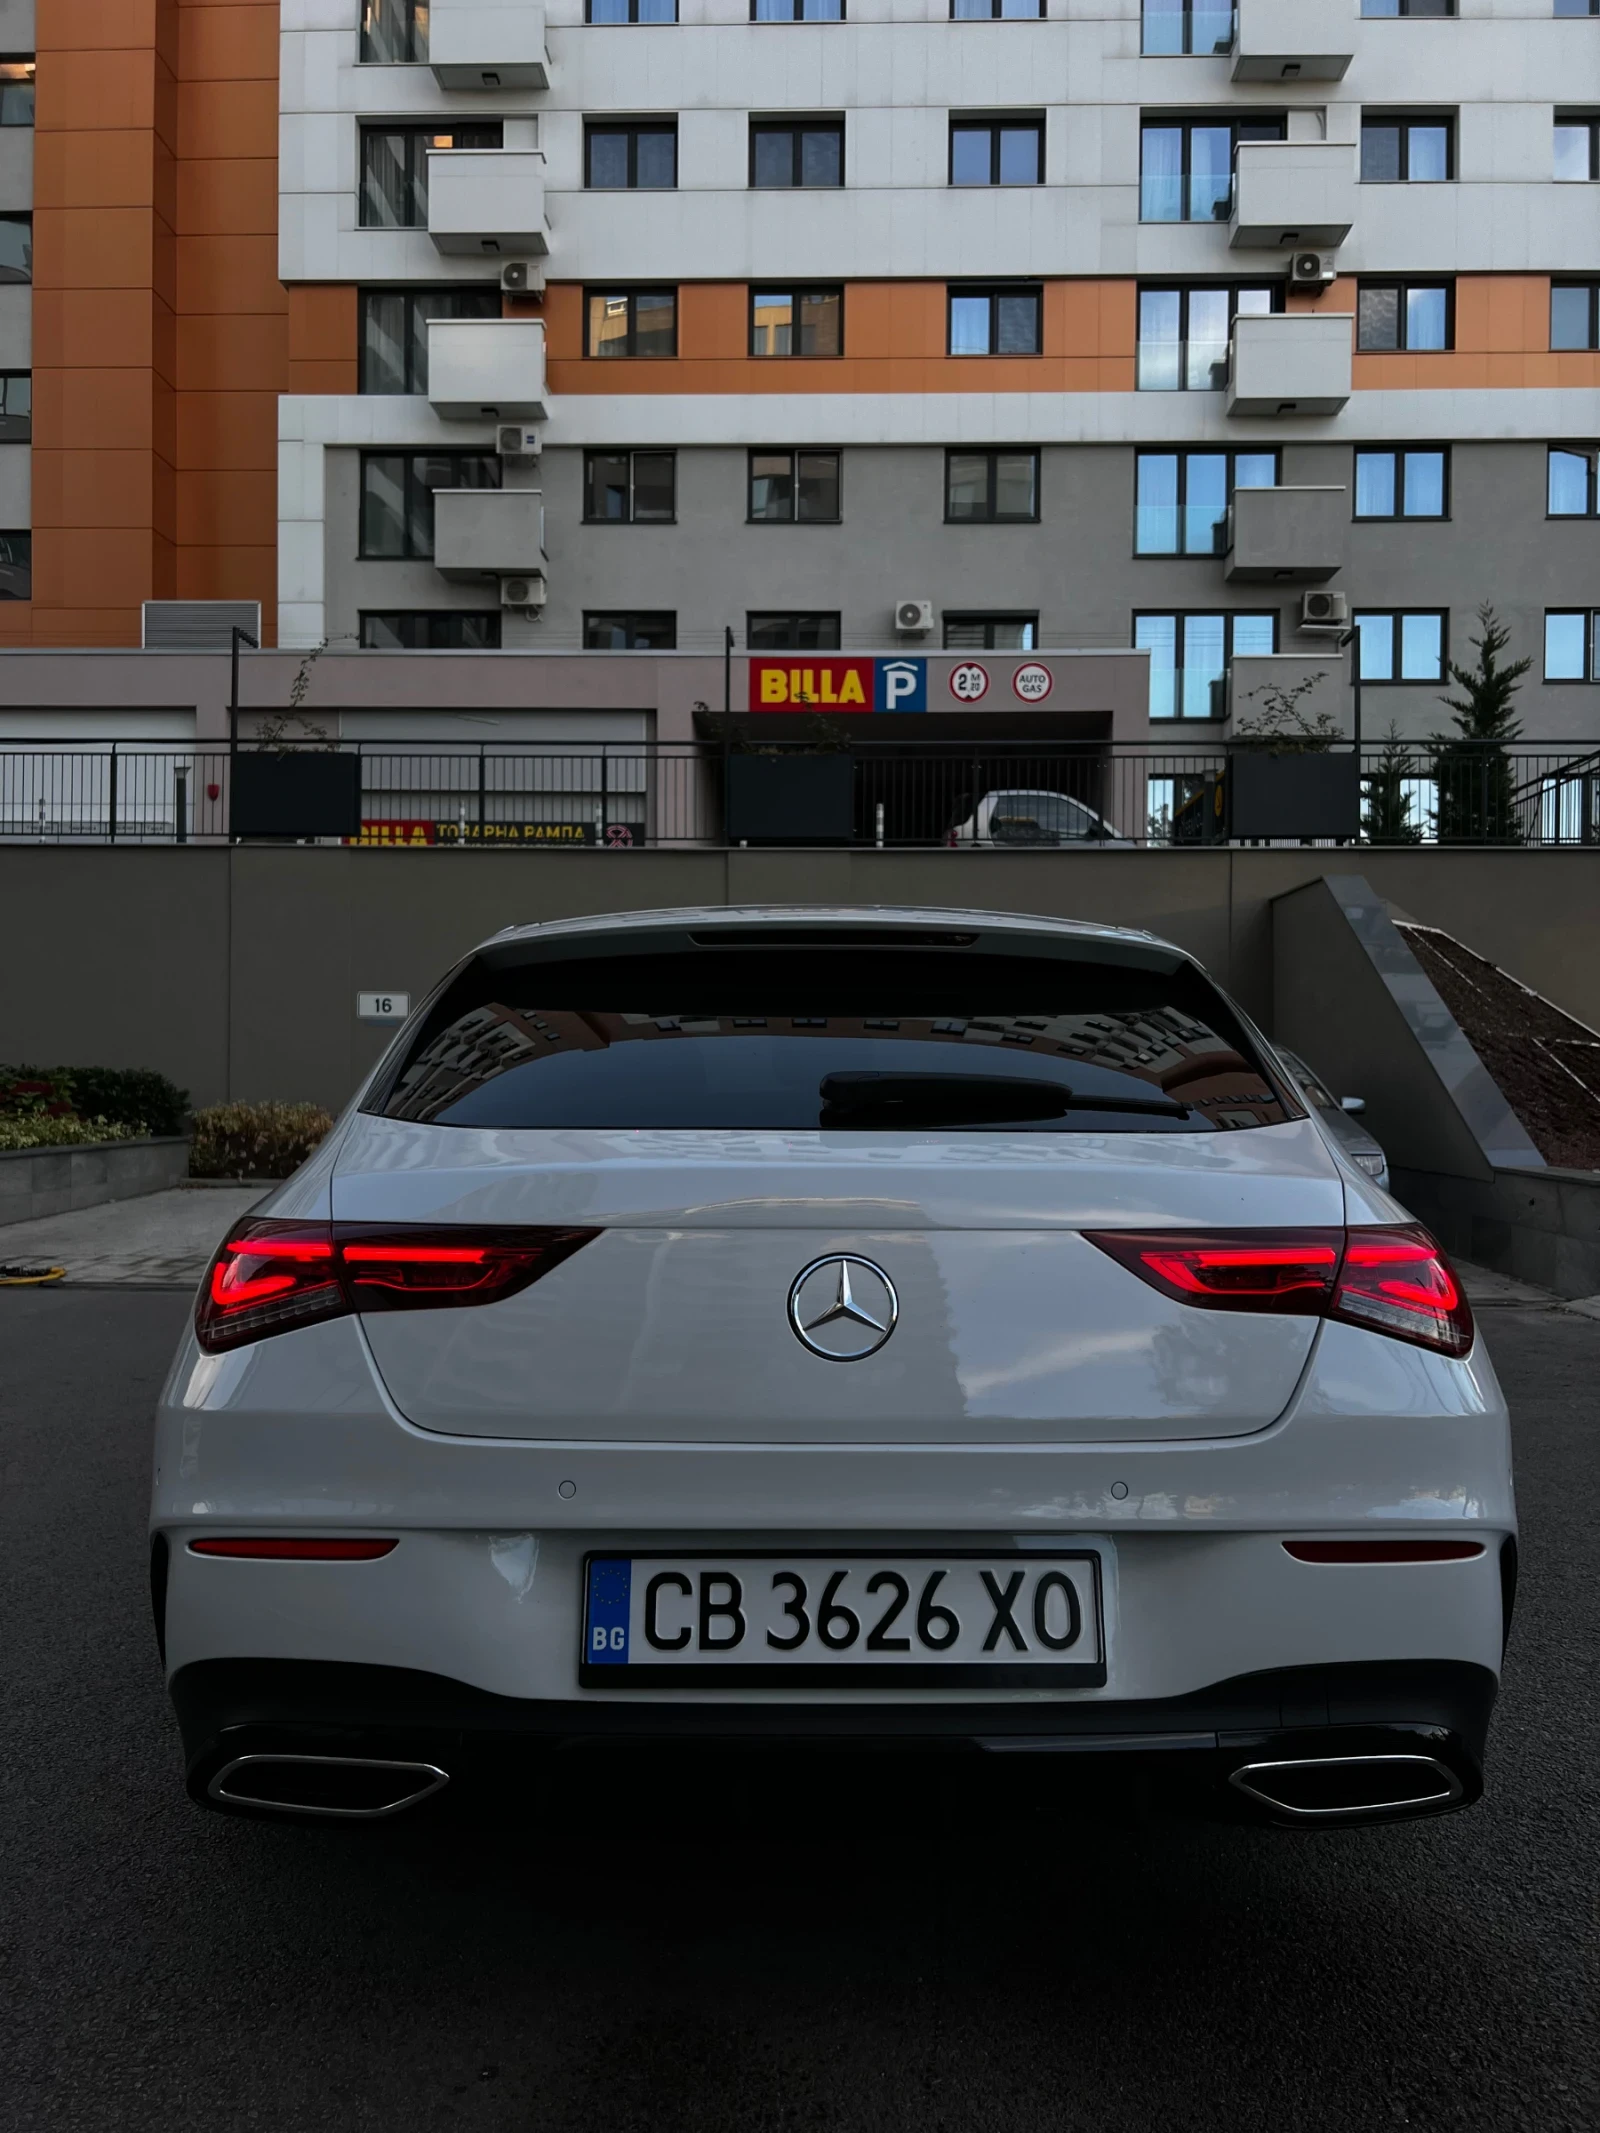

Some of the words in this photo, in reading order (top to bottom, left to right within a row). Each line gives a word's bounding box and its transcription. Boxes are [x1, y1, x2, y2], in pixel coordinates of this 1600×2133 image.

[760, 669, 866, 704] BILLA
[1019, 675, 1046, 683] AUTO
[1022, 685, 1042, 693] GAS
[886, 671, 917, 709] P
[524, 824, 585, 839] РАМПА
[375, 998, 392, 1013] 16
[644, 1571, 746, 1650] CB
[766, 1571, 960, 1650] 3626
[593, 1626, 625, 1651] BG
